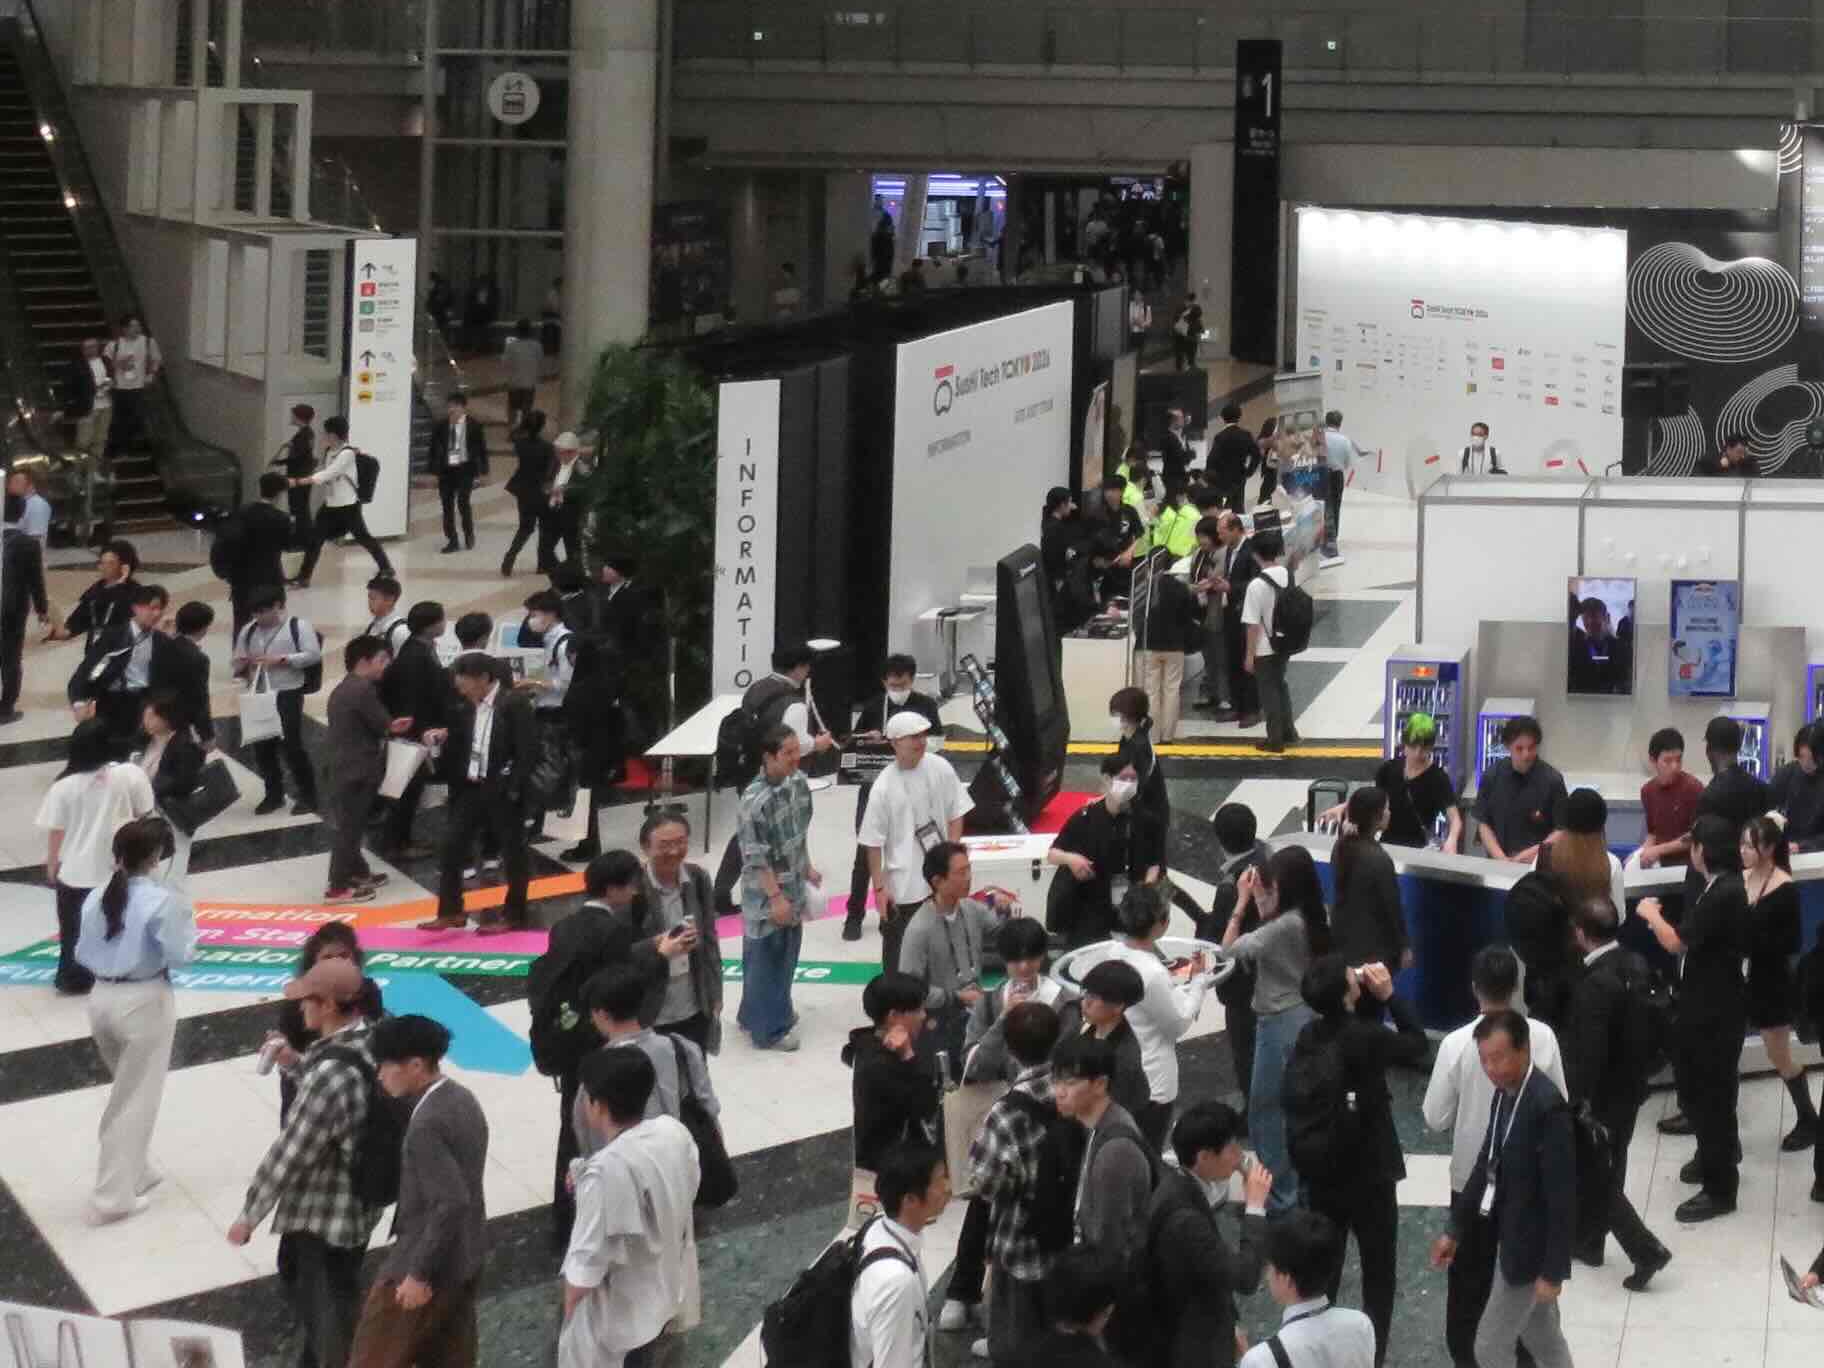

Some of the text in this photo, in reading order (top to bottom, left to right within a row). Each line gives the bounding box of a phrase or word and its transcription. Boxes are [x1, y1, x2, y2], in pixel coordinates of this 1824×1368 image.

[1261, 72, 1272, 117] 1
[733, 437, 756, 689] INFORMATIO
[365, 952, 528, 972] Partner
